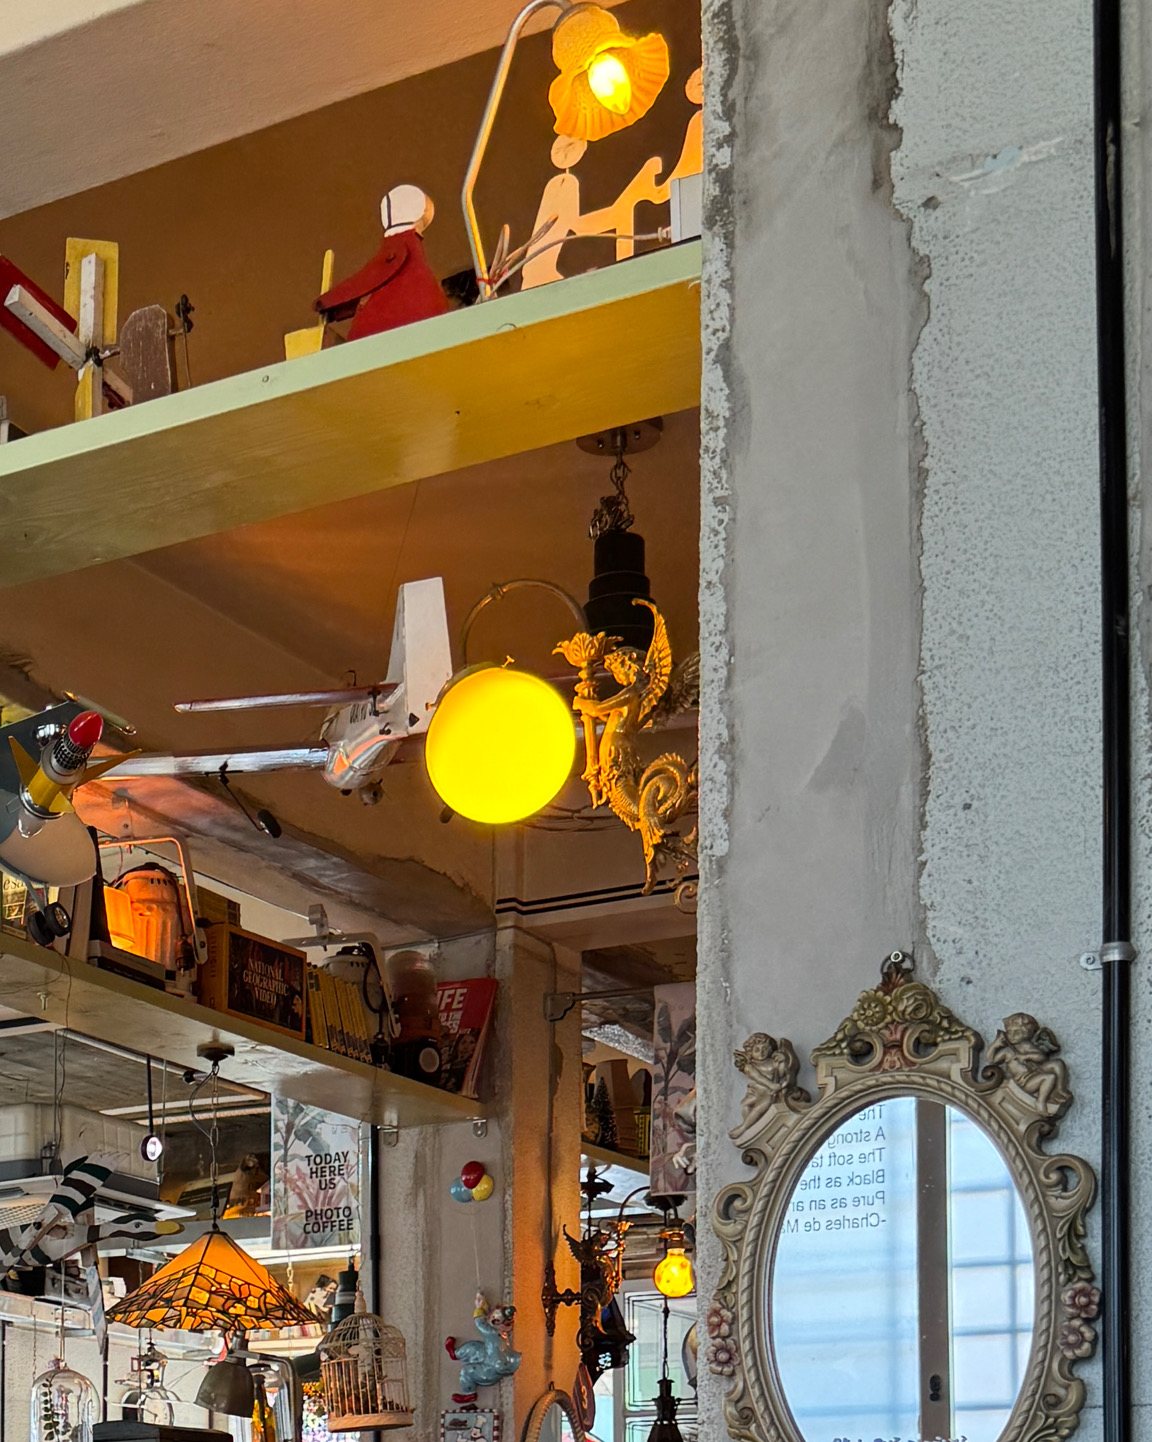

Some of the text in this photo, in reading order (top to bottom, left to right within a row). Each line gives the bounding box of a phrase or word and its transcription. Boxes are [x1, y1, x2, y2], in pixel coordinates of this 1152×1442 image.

[248, 958, 284, 981] NATIONAL
[243, 969, 289, 996] GEOGRAPHIC
[253, 986, 277, 1006] VIDEO
[436, 988, 467, 1010] IFE
[305, 1151, 349, 1167] TODAY
[309, 1164, 345, 1179] HERE
[318, 1178, 336, 1190] US
[305, 1206, 352, 1222] PHOTO
[303, 1219, 354, 1234] COFFEE
